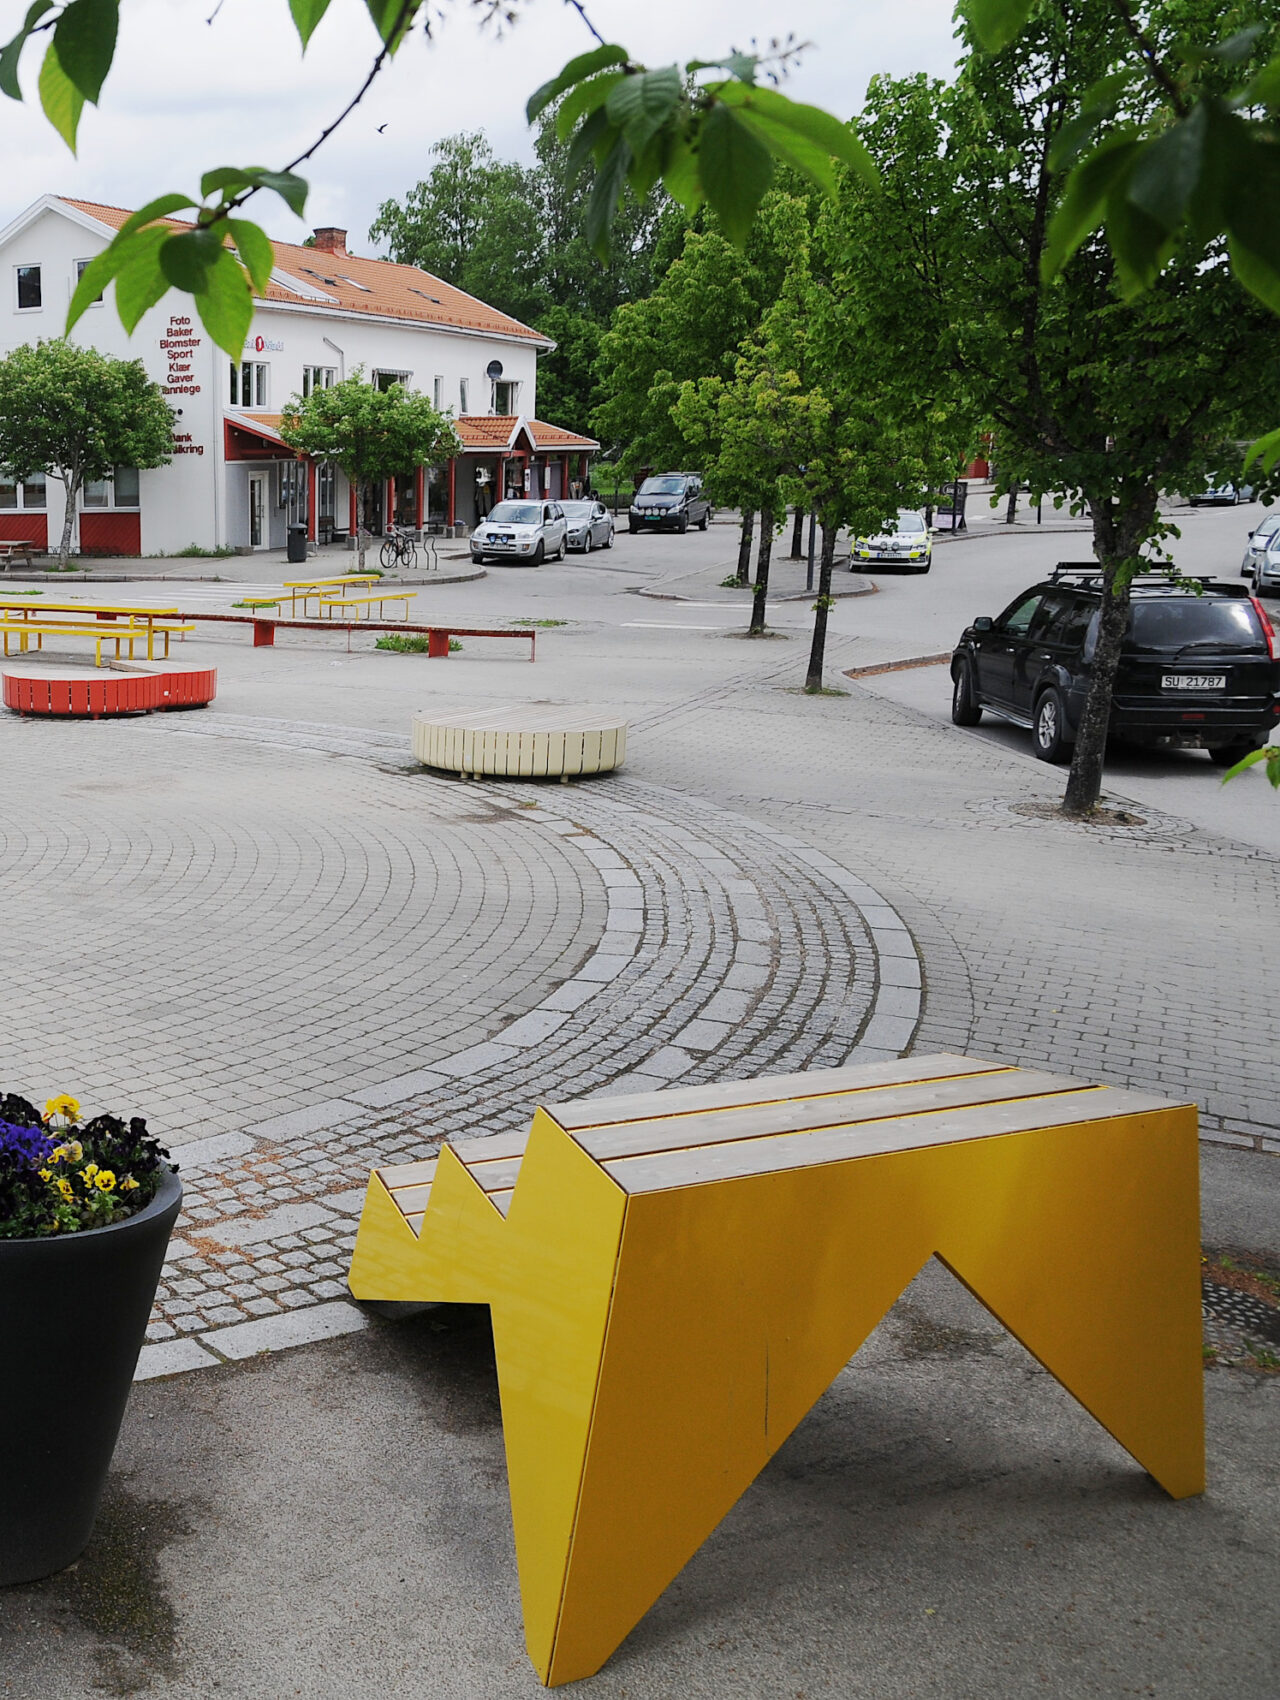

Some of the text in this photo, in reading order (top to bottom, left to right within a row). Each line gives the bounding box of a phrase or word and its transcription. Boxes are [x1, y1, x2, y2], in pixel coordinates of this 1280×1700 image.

[170, 316, 191, 326] Foto
[166, 327, 193, 338] Baker
[160, 338, 201, 349] Blomster
[167, 349, 193, 360] Sport
[169, 362, 191, 373] Klær
[167, 373, 195, 383] Gaver
[1165, 676, 1223, 687] SU 21787
